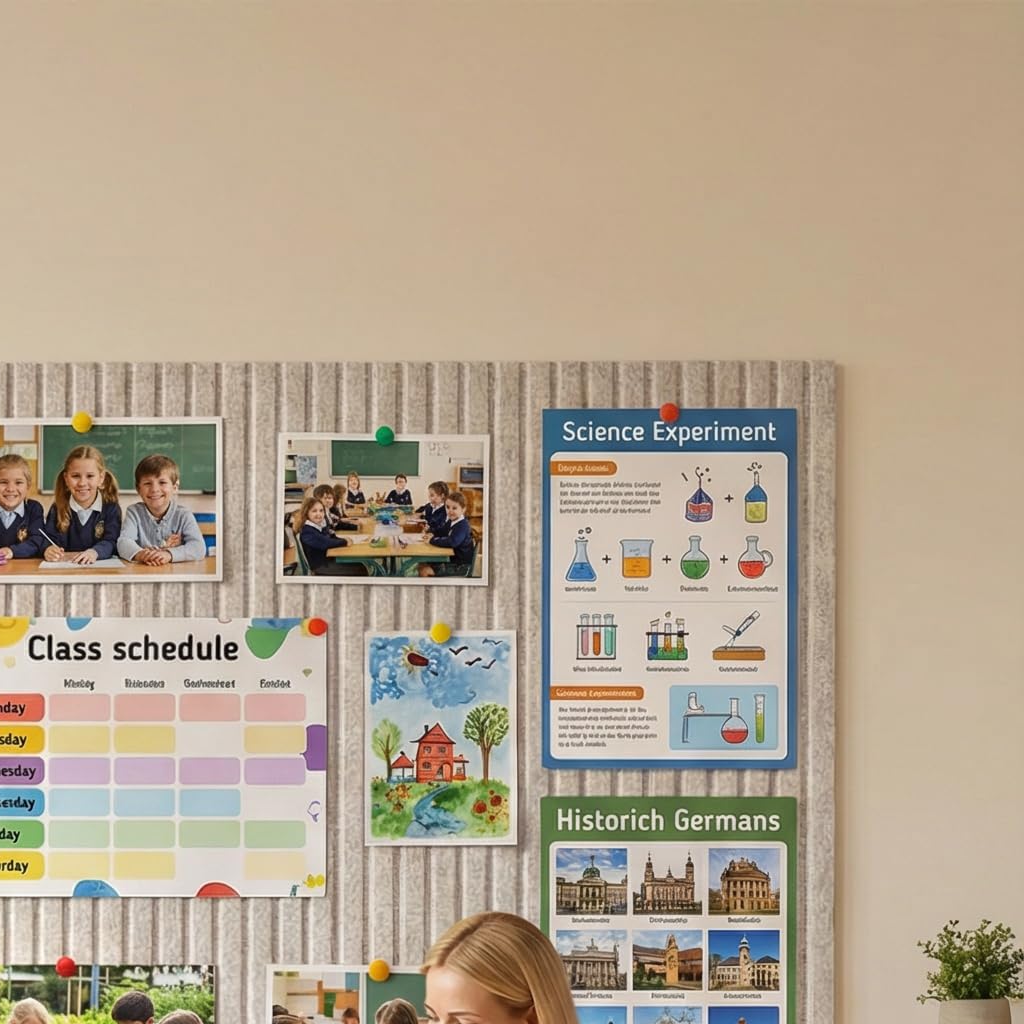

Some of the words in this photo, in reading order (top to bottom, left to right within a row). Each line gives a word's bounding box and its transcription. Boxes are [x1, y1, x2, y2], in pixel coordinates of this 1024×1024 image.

[562, 421, 645, 442] Science
[653, 421, 777, 447] Experiment
[28, 634, 102, 661] Class
[113, 634, 239, 661] schedule
[557, 808, 664, 831] Historich
[674, 808, 780, 831] Germans
